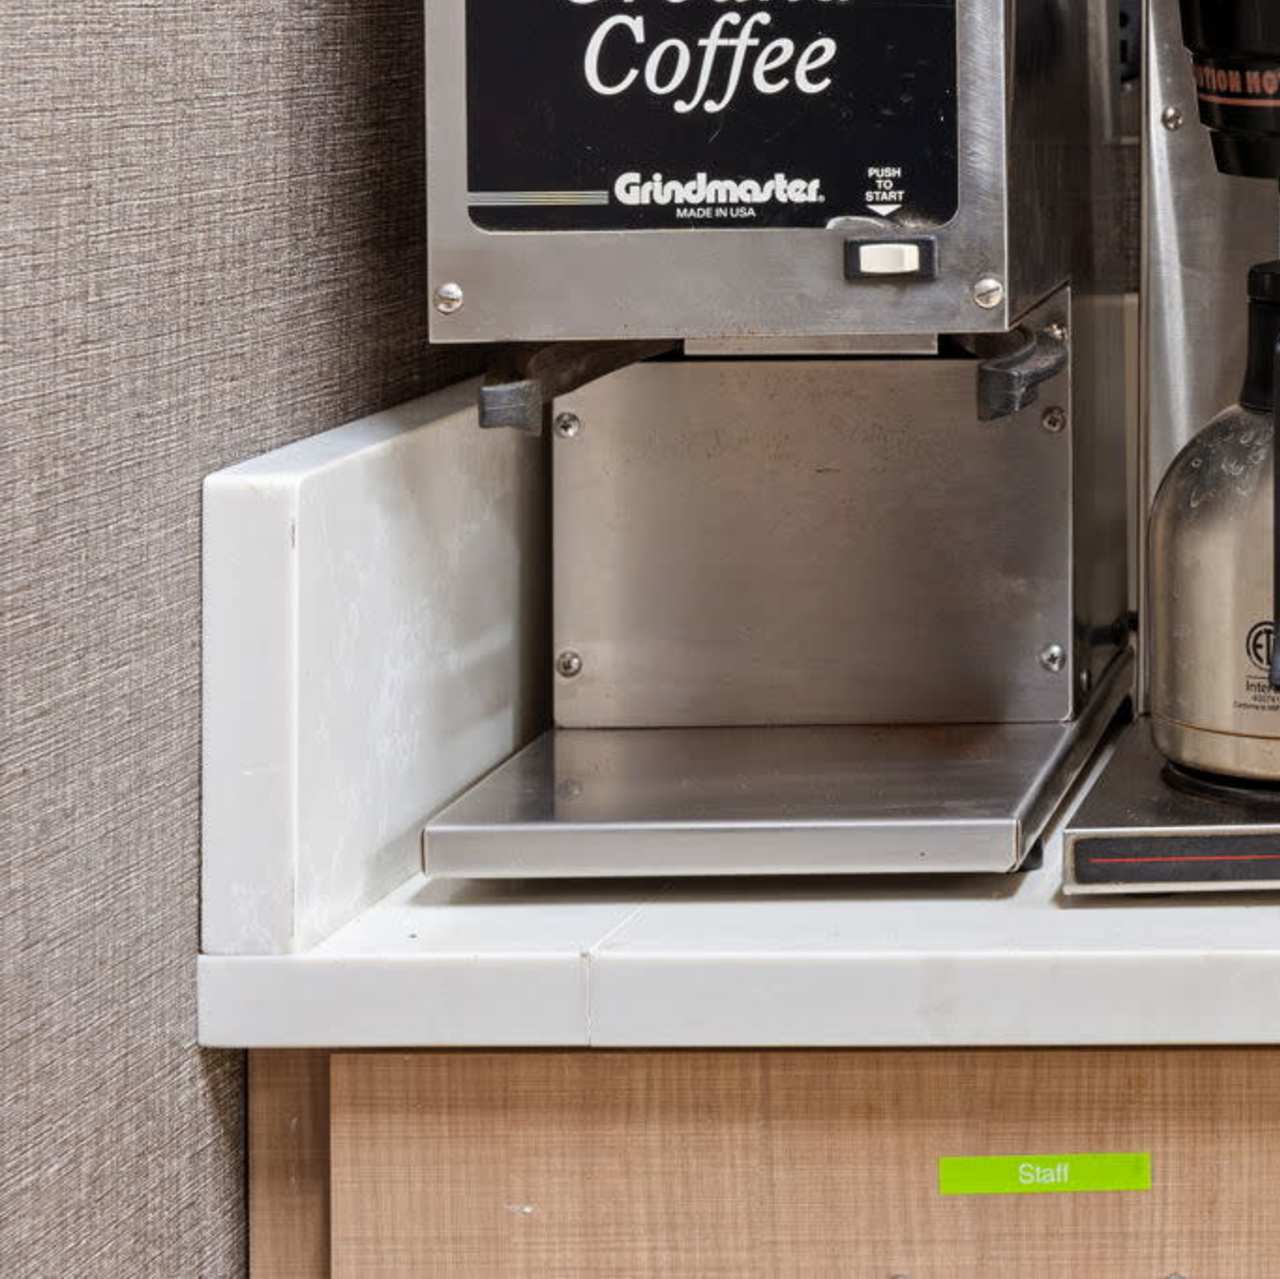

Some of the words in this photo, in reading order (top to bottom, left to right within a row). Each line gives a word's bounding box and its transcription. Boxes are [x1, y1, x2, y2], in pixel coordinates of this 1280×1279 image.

[583, 11, 837, 114] Coffee
[867, 167, 902, 178] PUSH
[875, 179, 893, 190] TO
[865, 190, 905, 202] START
[676, 207, 713, 219] MADE
[715, 207, 728, 218] IN
[730, 207, 756, 218] USA
[1017, 1162, 1070, 1185] Staff
